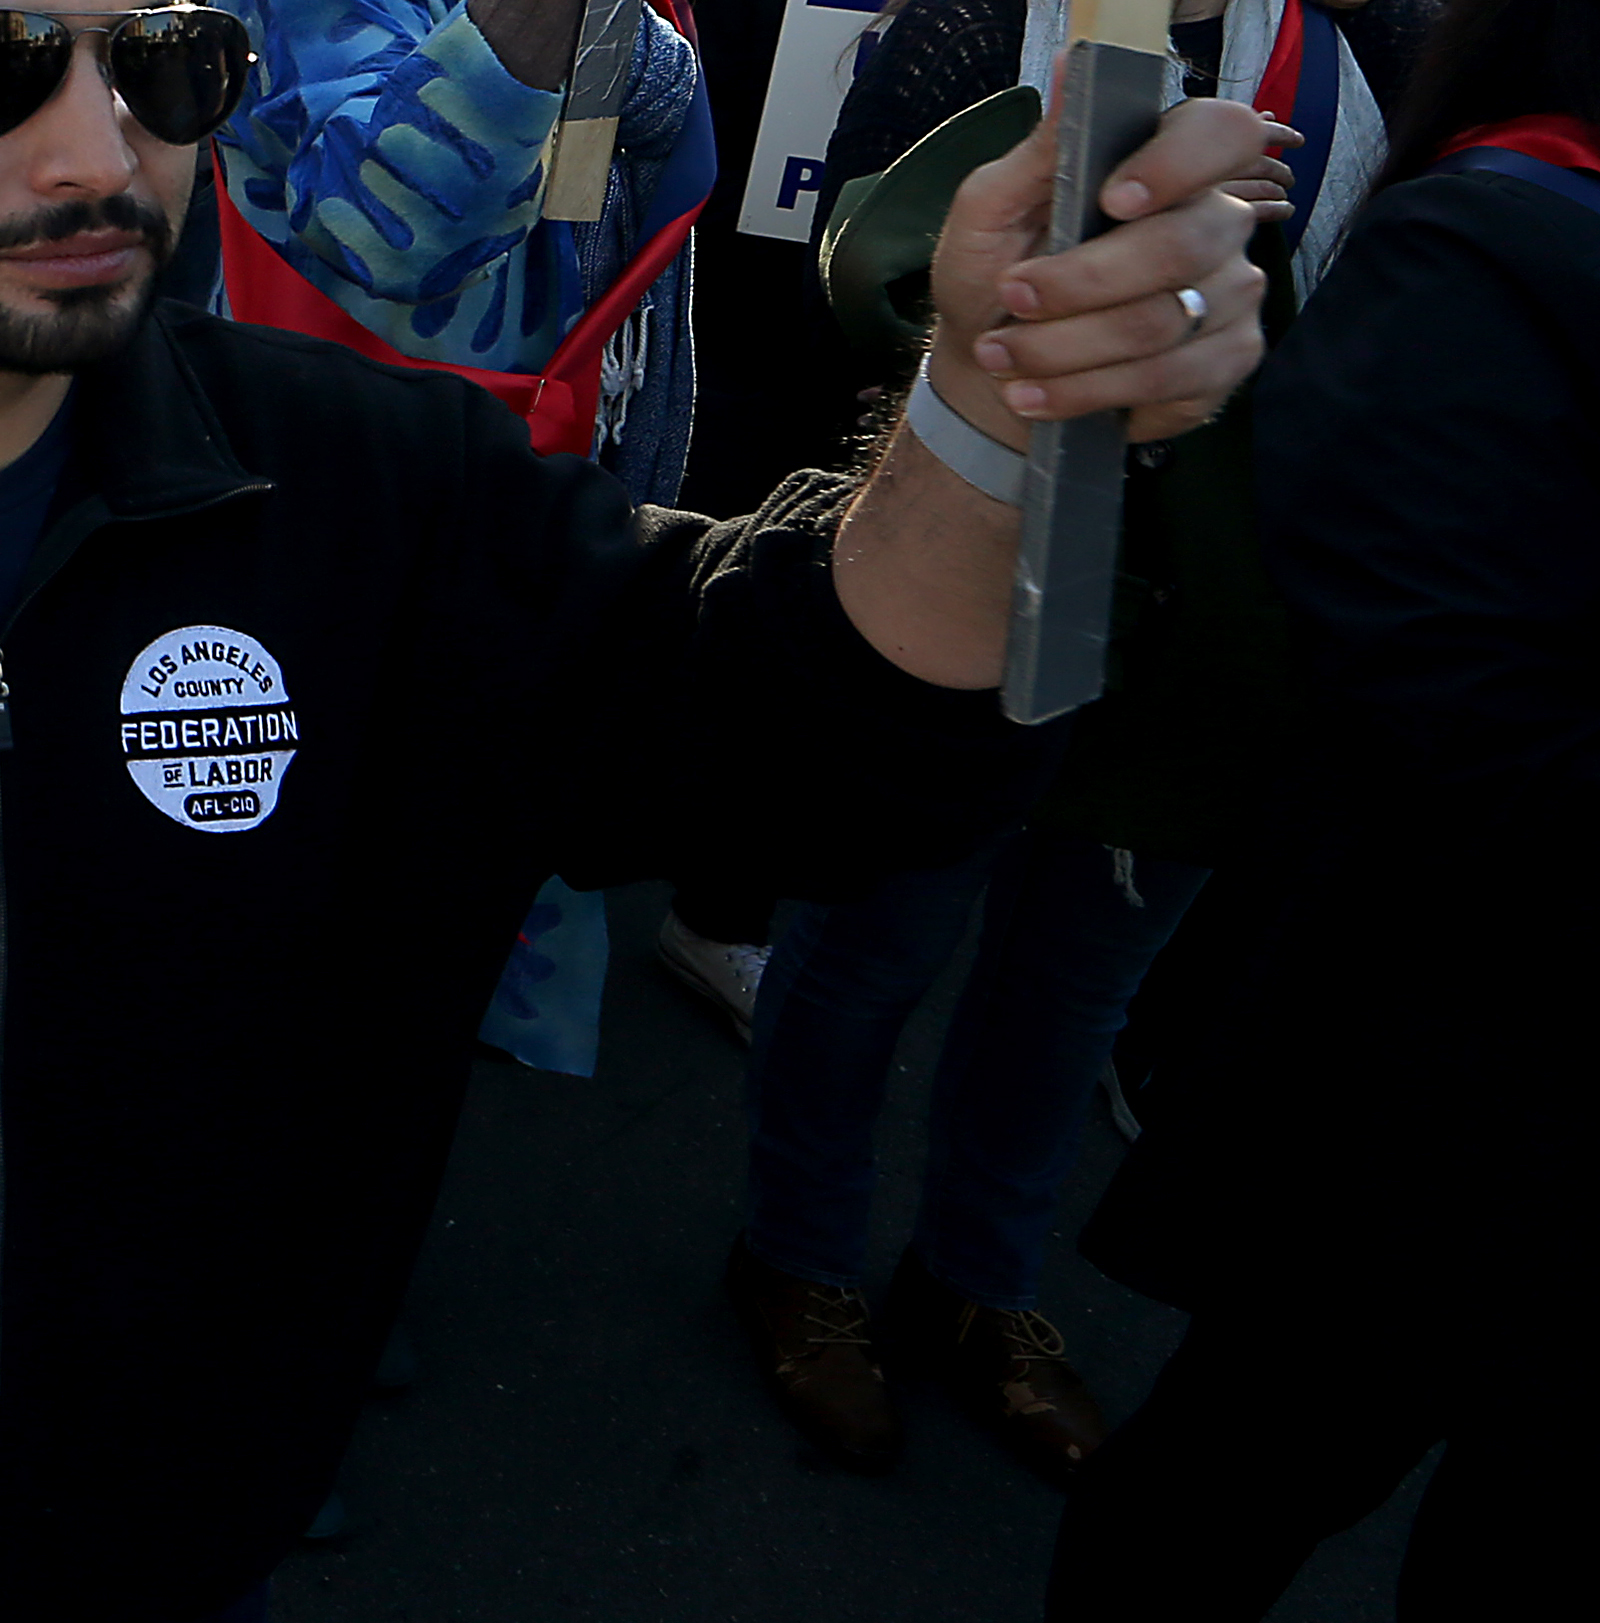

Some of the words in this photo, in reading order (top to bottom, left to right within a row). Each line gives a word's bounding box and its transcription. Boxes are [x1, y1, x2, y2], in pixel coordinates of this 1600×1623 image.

[141, 654, 179, 699] LOS
[180, 640, 274, 695] ANGELES
[173, 676, 245, 699] COUNTY
[120, 710, 299, 754] FEDERATION
[164, 769, 183, 783] OF
[187, 756, 273, 788] LABOR
[191, 795, 256, 816] AFL-CIO
